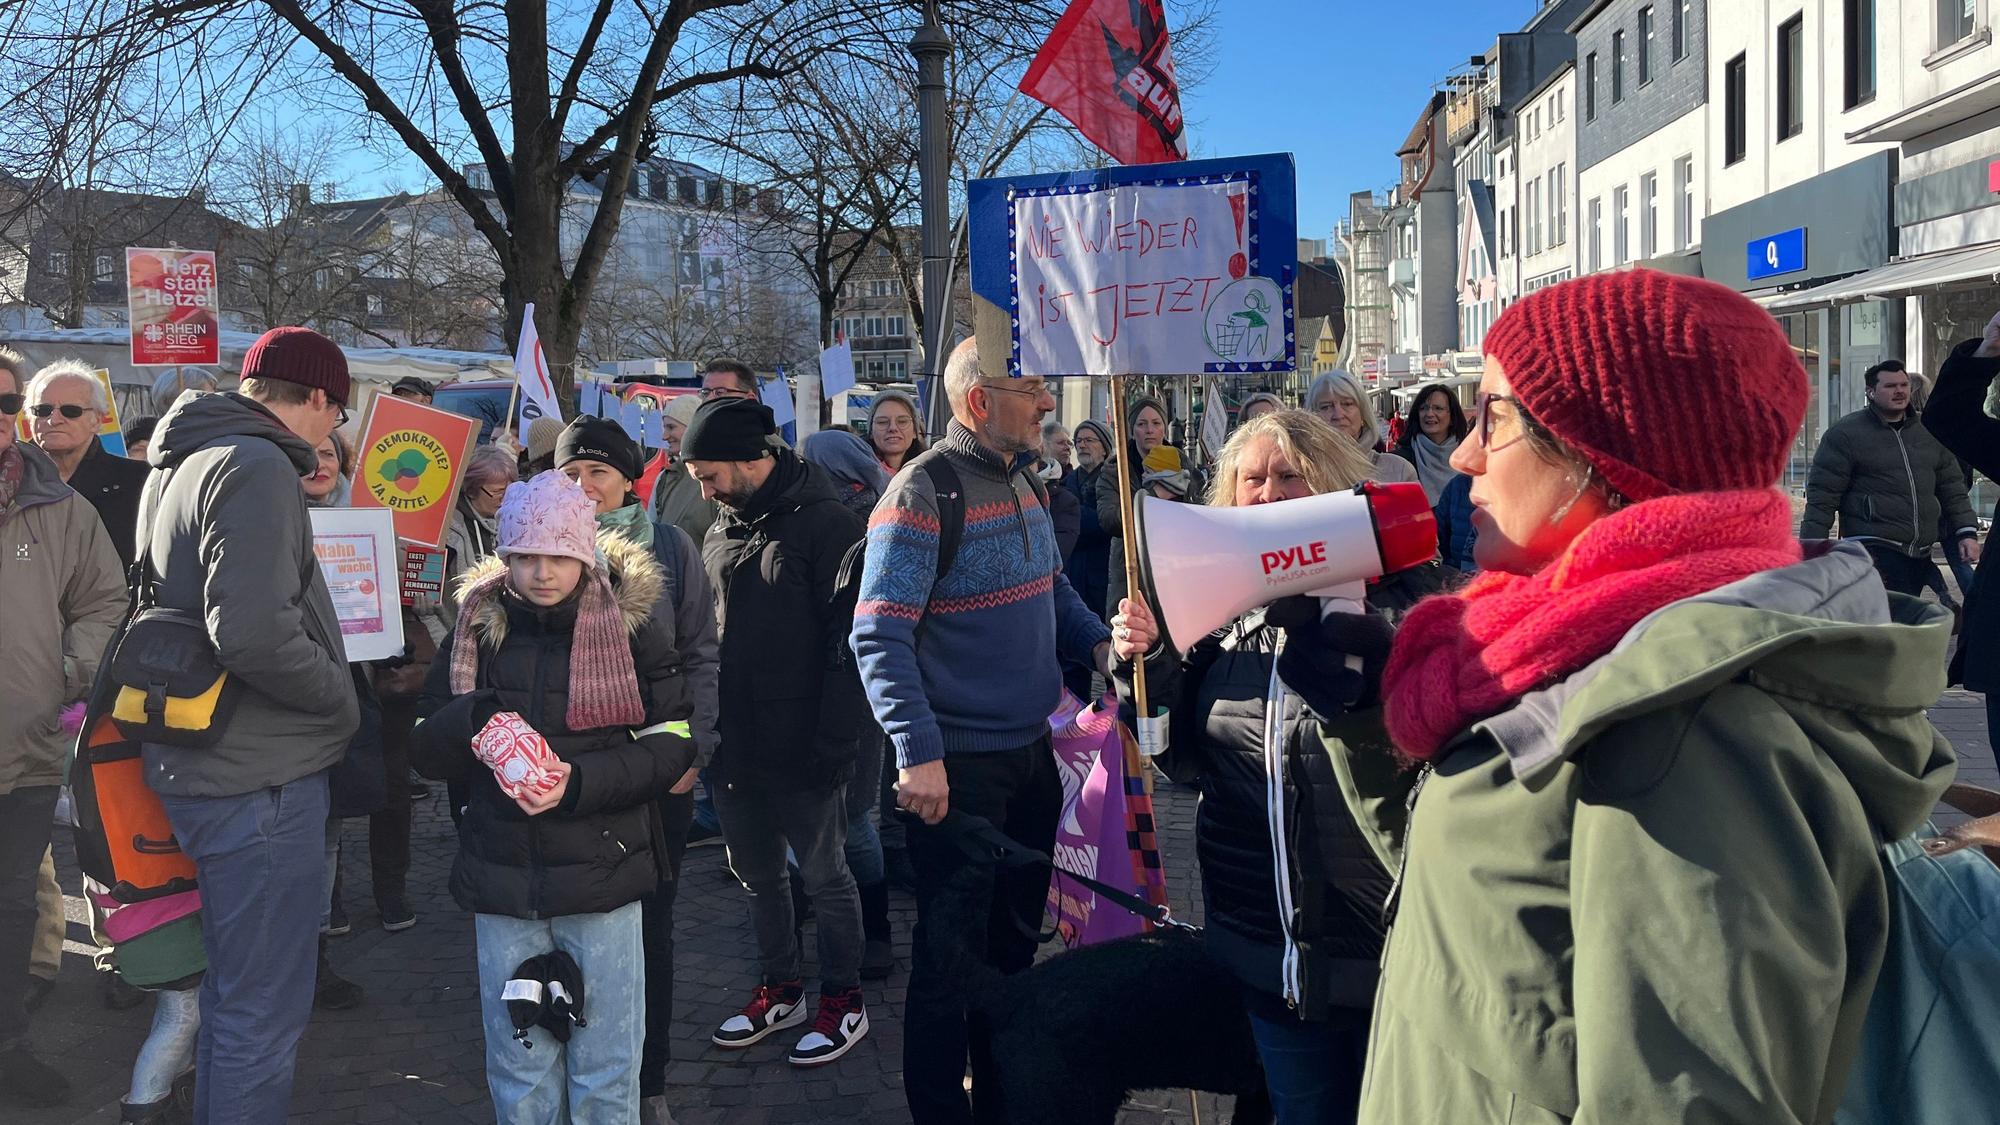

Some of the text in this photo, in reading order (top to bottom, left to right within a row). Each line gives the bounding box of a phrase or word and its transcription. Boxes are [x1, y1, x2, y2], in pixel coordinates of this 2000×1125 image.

[162, 257, 211, 276] Herz
[164, 275, 212, 291] statt
[144, 288, 212, 307] Hetze!
[1088, 276, 1221, 346] JETZT
[165, 323, 206, 334] RHEIN
[166, 334, 198, 345] SIEG
[376, 432, 449, 470] DEMOKRATIE?
[372, 483, 429, 509] JA, BITTE!
[313, 543, 356, 558] Mahn
[1261, 541, 1327, 575] PYLE
[337, 560, 373, 574] wache
[487, 733, 510, 757] CORN
